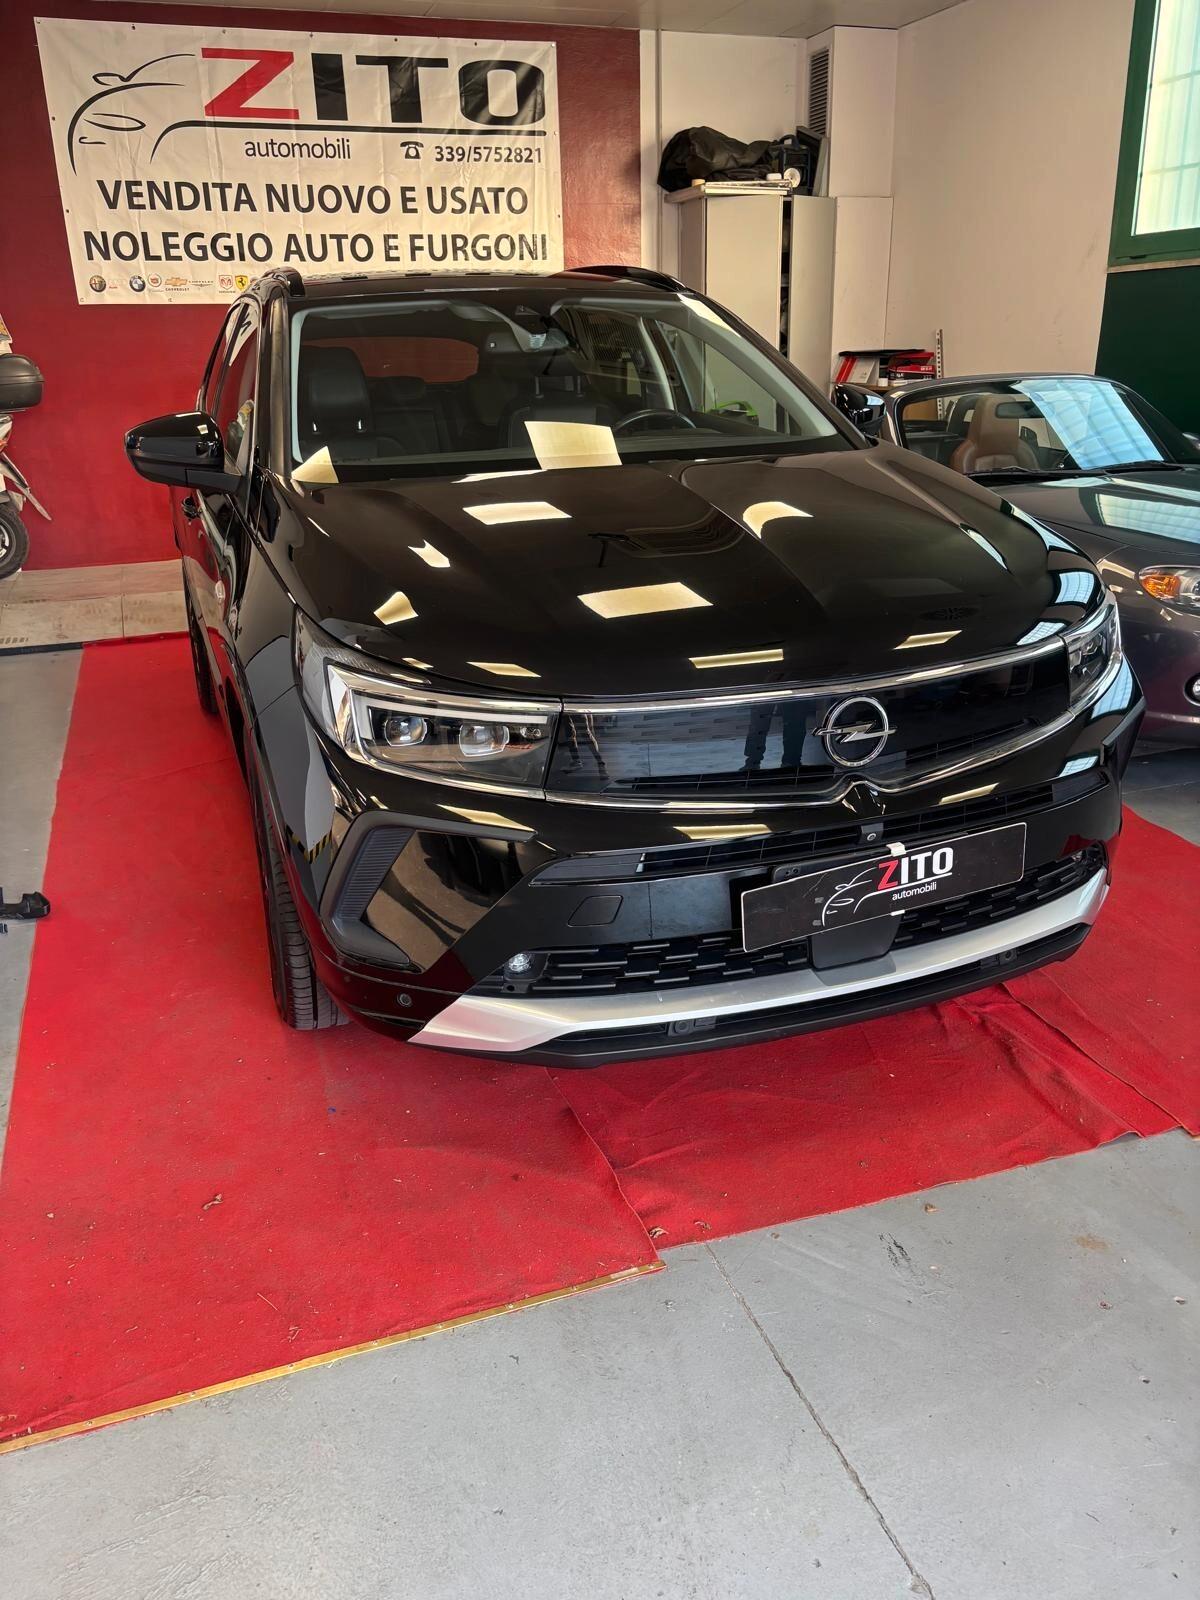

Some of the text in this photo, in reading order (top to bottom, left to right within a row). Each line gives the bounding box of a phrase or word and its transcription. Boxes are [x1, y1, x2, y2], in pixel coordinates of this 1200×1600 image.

[201, 48, 546, 126] ZITO
[245, 137, 351, 160] automobili
[434, 145, 543, 164] 339/5752821
[97, 180, 528, 214] VENDITA NUOVO E USATO
[84, 231, 548, 262] NOLEGGIO AUTO E FURGONI
[878, 848, 952, 890] ZITO
[892, 882, 936, 901] automobili
